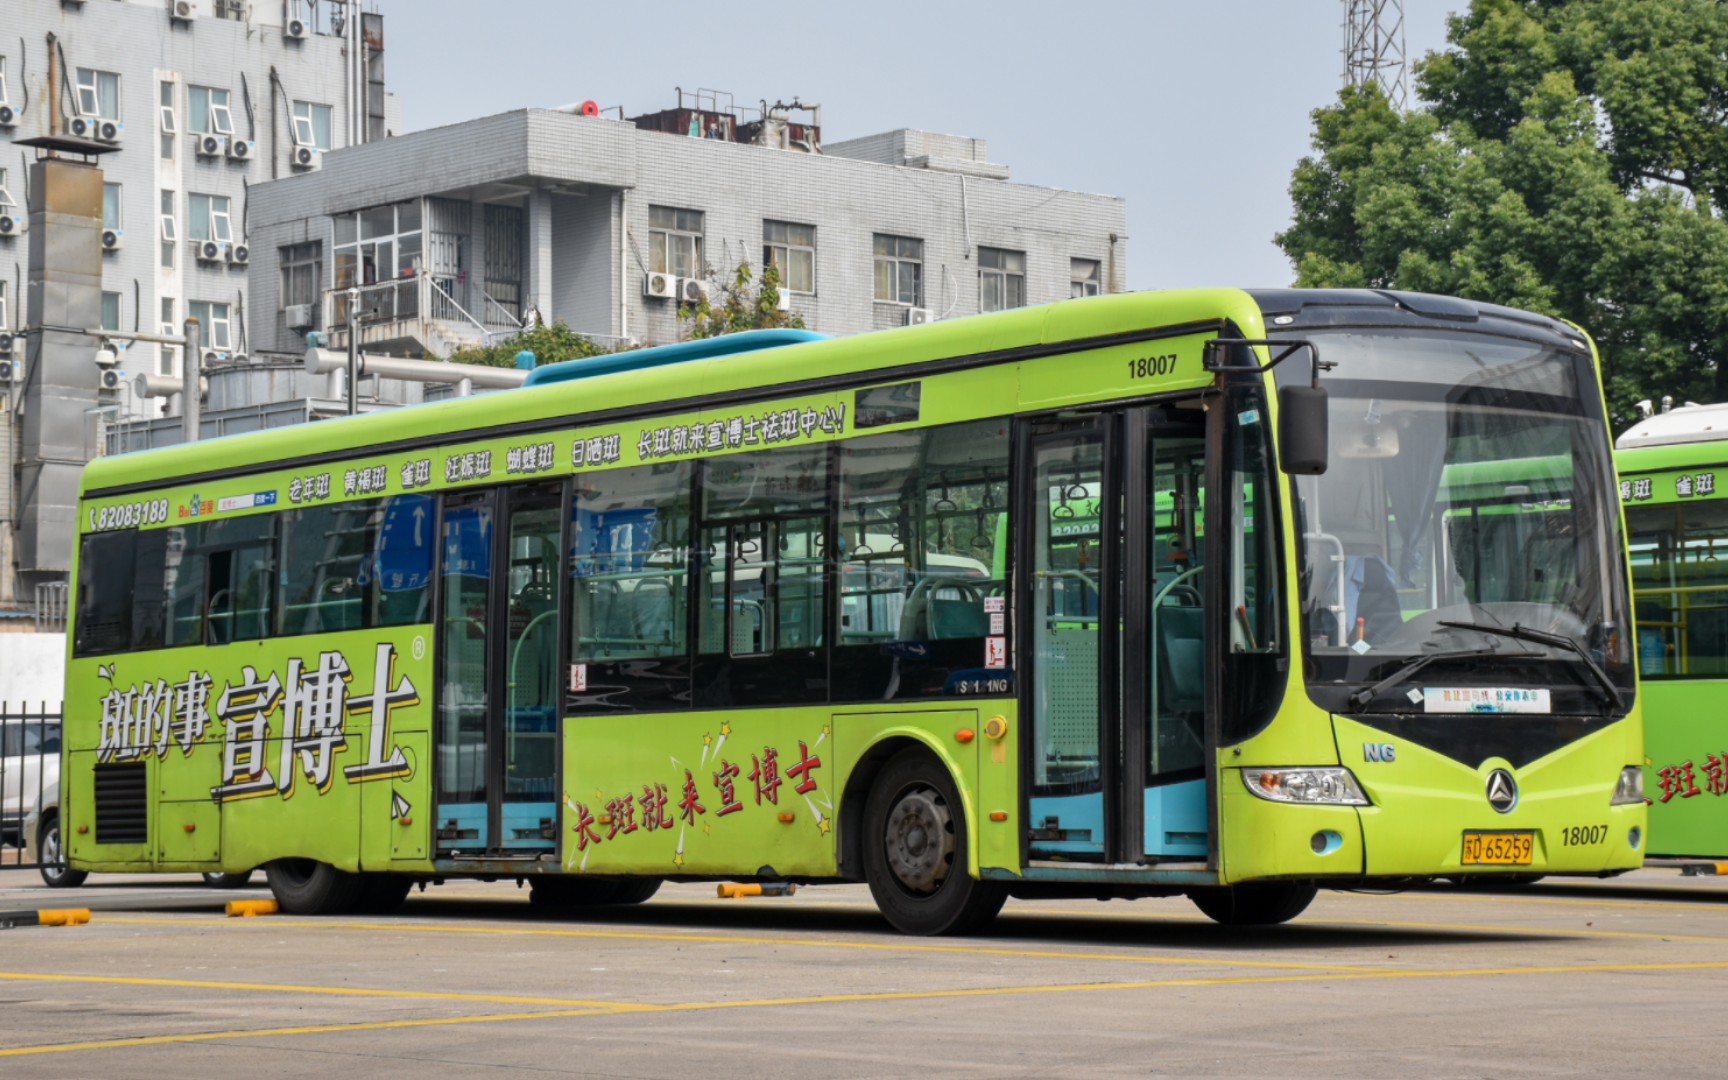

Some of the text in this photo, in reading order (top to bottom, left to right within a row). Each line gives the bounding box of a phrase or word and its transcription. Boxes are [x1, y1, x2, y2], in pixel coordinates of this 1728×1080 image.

[1128, 354, 1177, 379] 18007
[289, 402, 846, 503] 老年斑 黄褐斑 雀斑 妊娠斑 蝴蝶斑 日晒斑 长斑就来宣博士祛斑中心!
[1676, 473, 1715, 497] 雀斑
[98, 499, 168, 530] 82083188
[210, 642, 421, 802] 宣博士
[1363, 743, 1396, 762] NG
[1643, 751, 1728, 806] 斑就
[572, 740, 822, 851] 长斑就来宣博士
[1561, 825, 1608, 847] 18007
